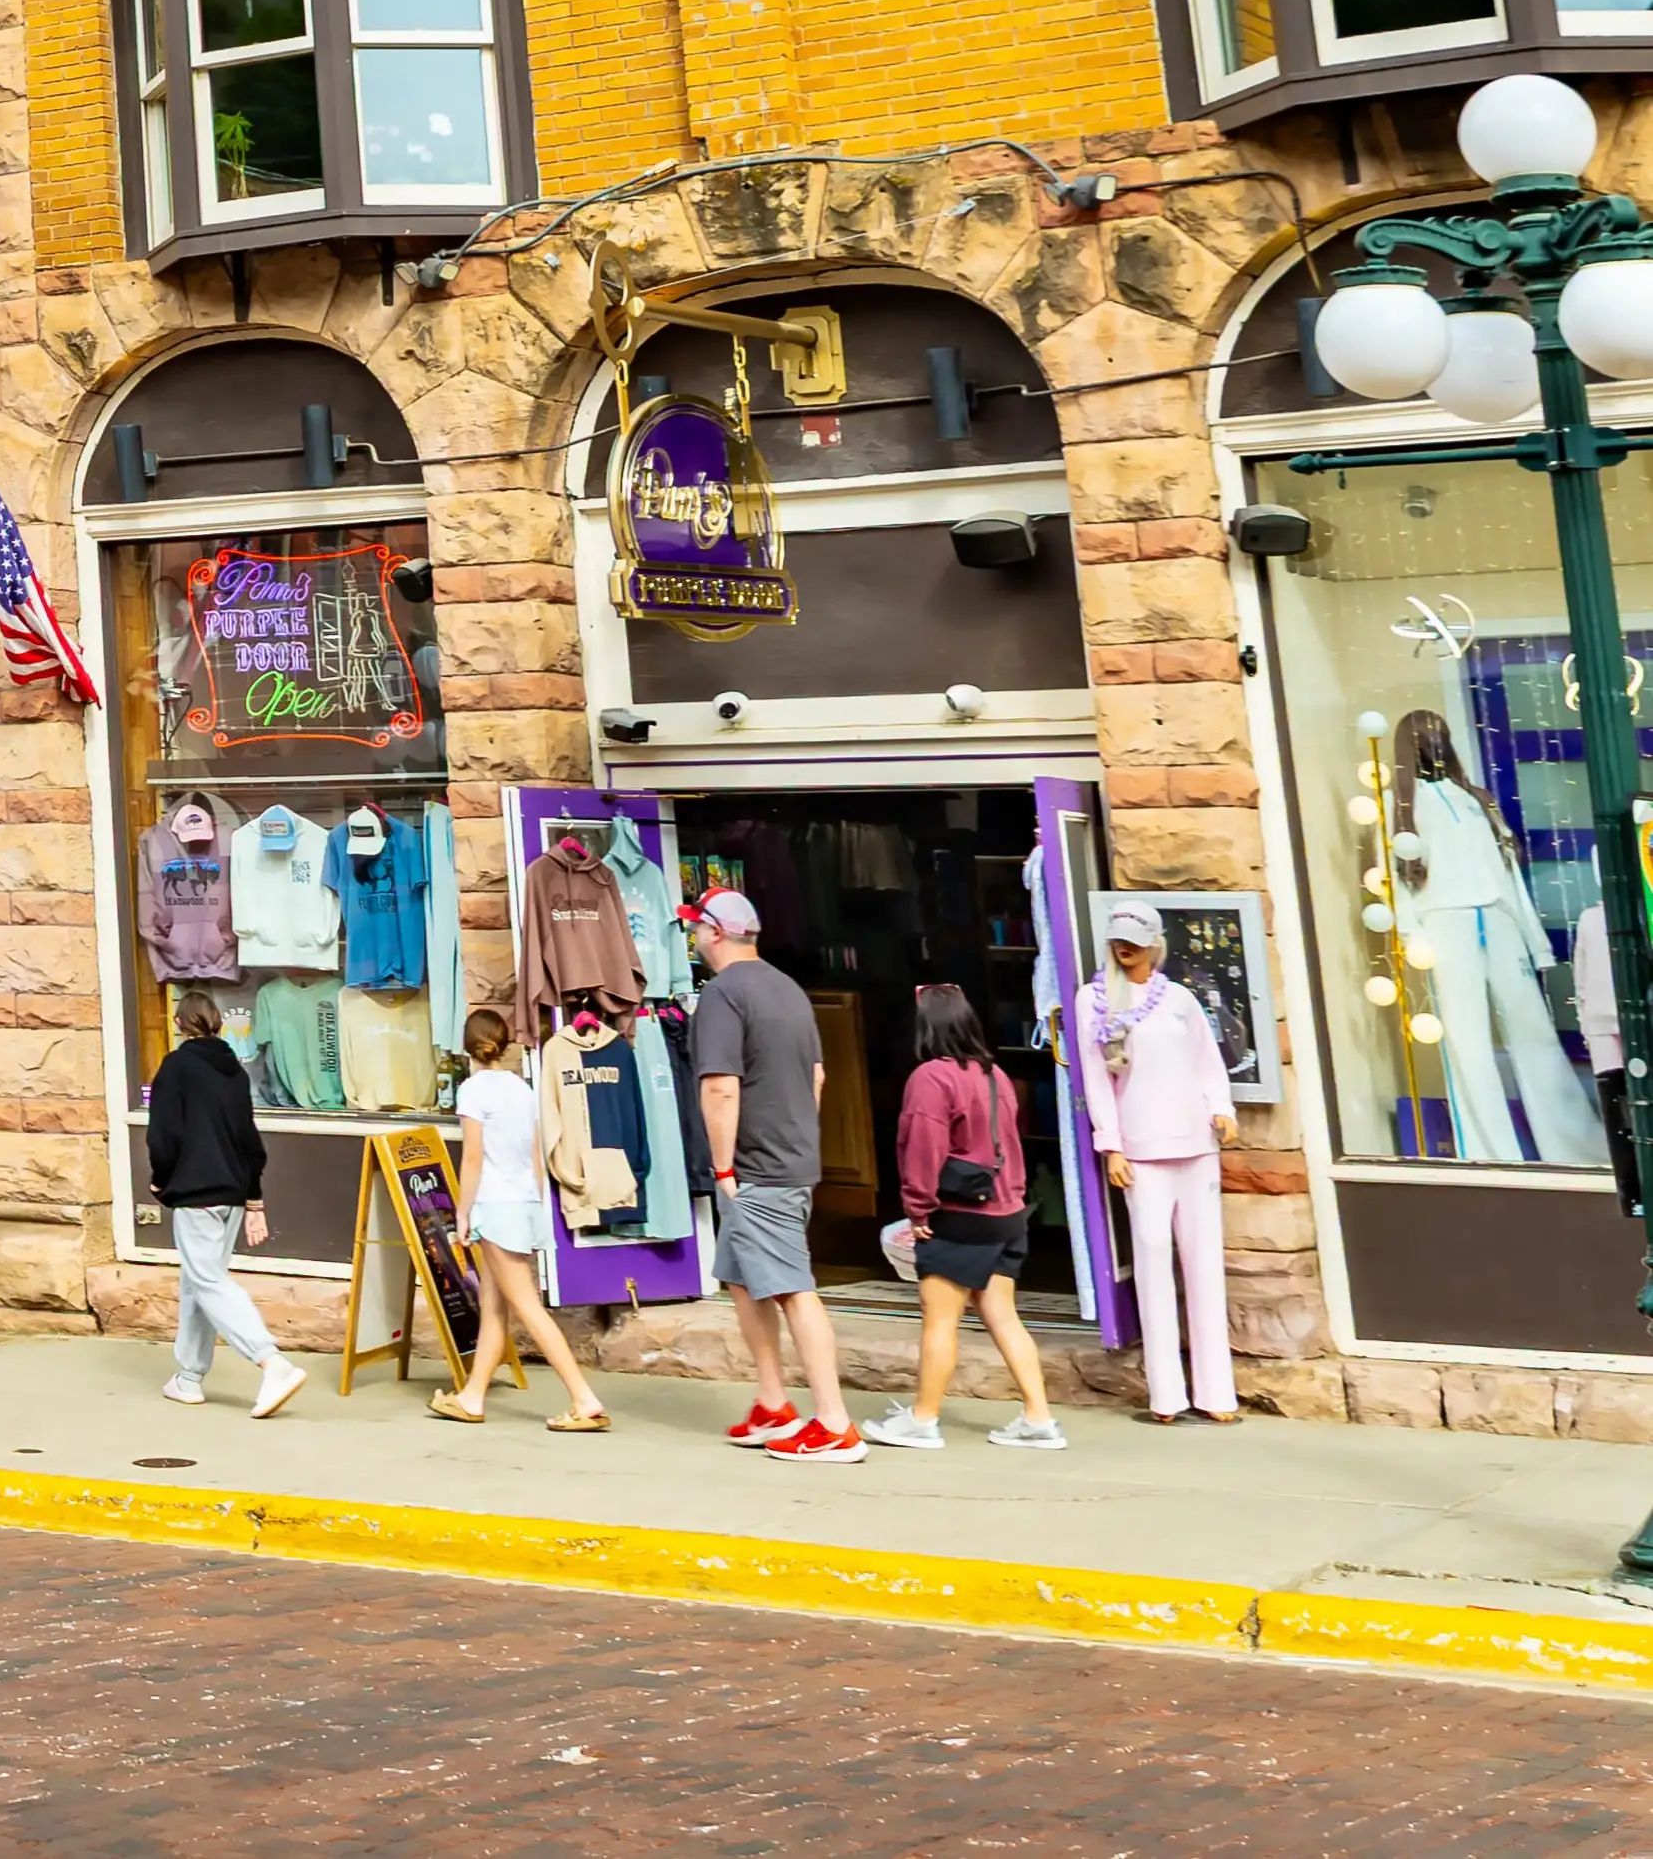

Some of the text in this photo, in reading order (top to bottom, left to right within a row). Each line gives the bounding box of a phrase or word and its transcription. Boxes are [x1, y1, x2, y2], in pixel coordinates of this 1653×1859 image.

[204, 606, 311, 639] PURPLE
[235, 641, 313, 673] DOOR
[245, 670, 337, 726] Open
